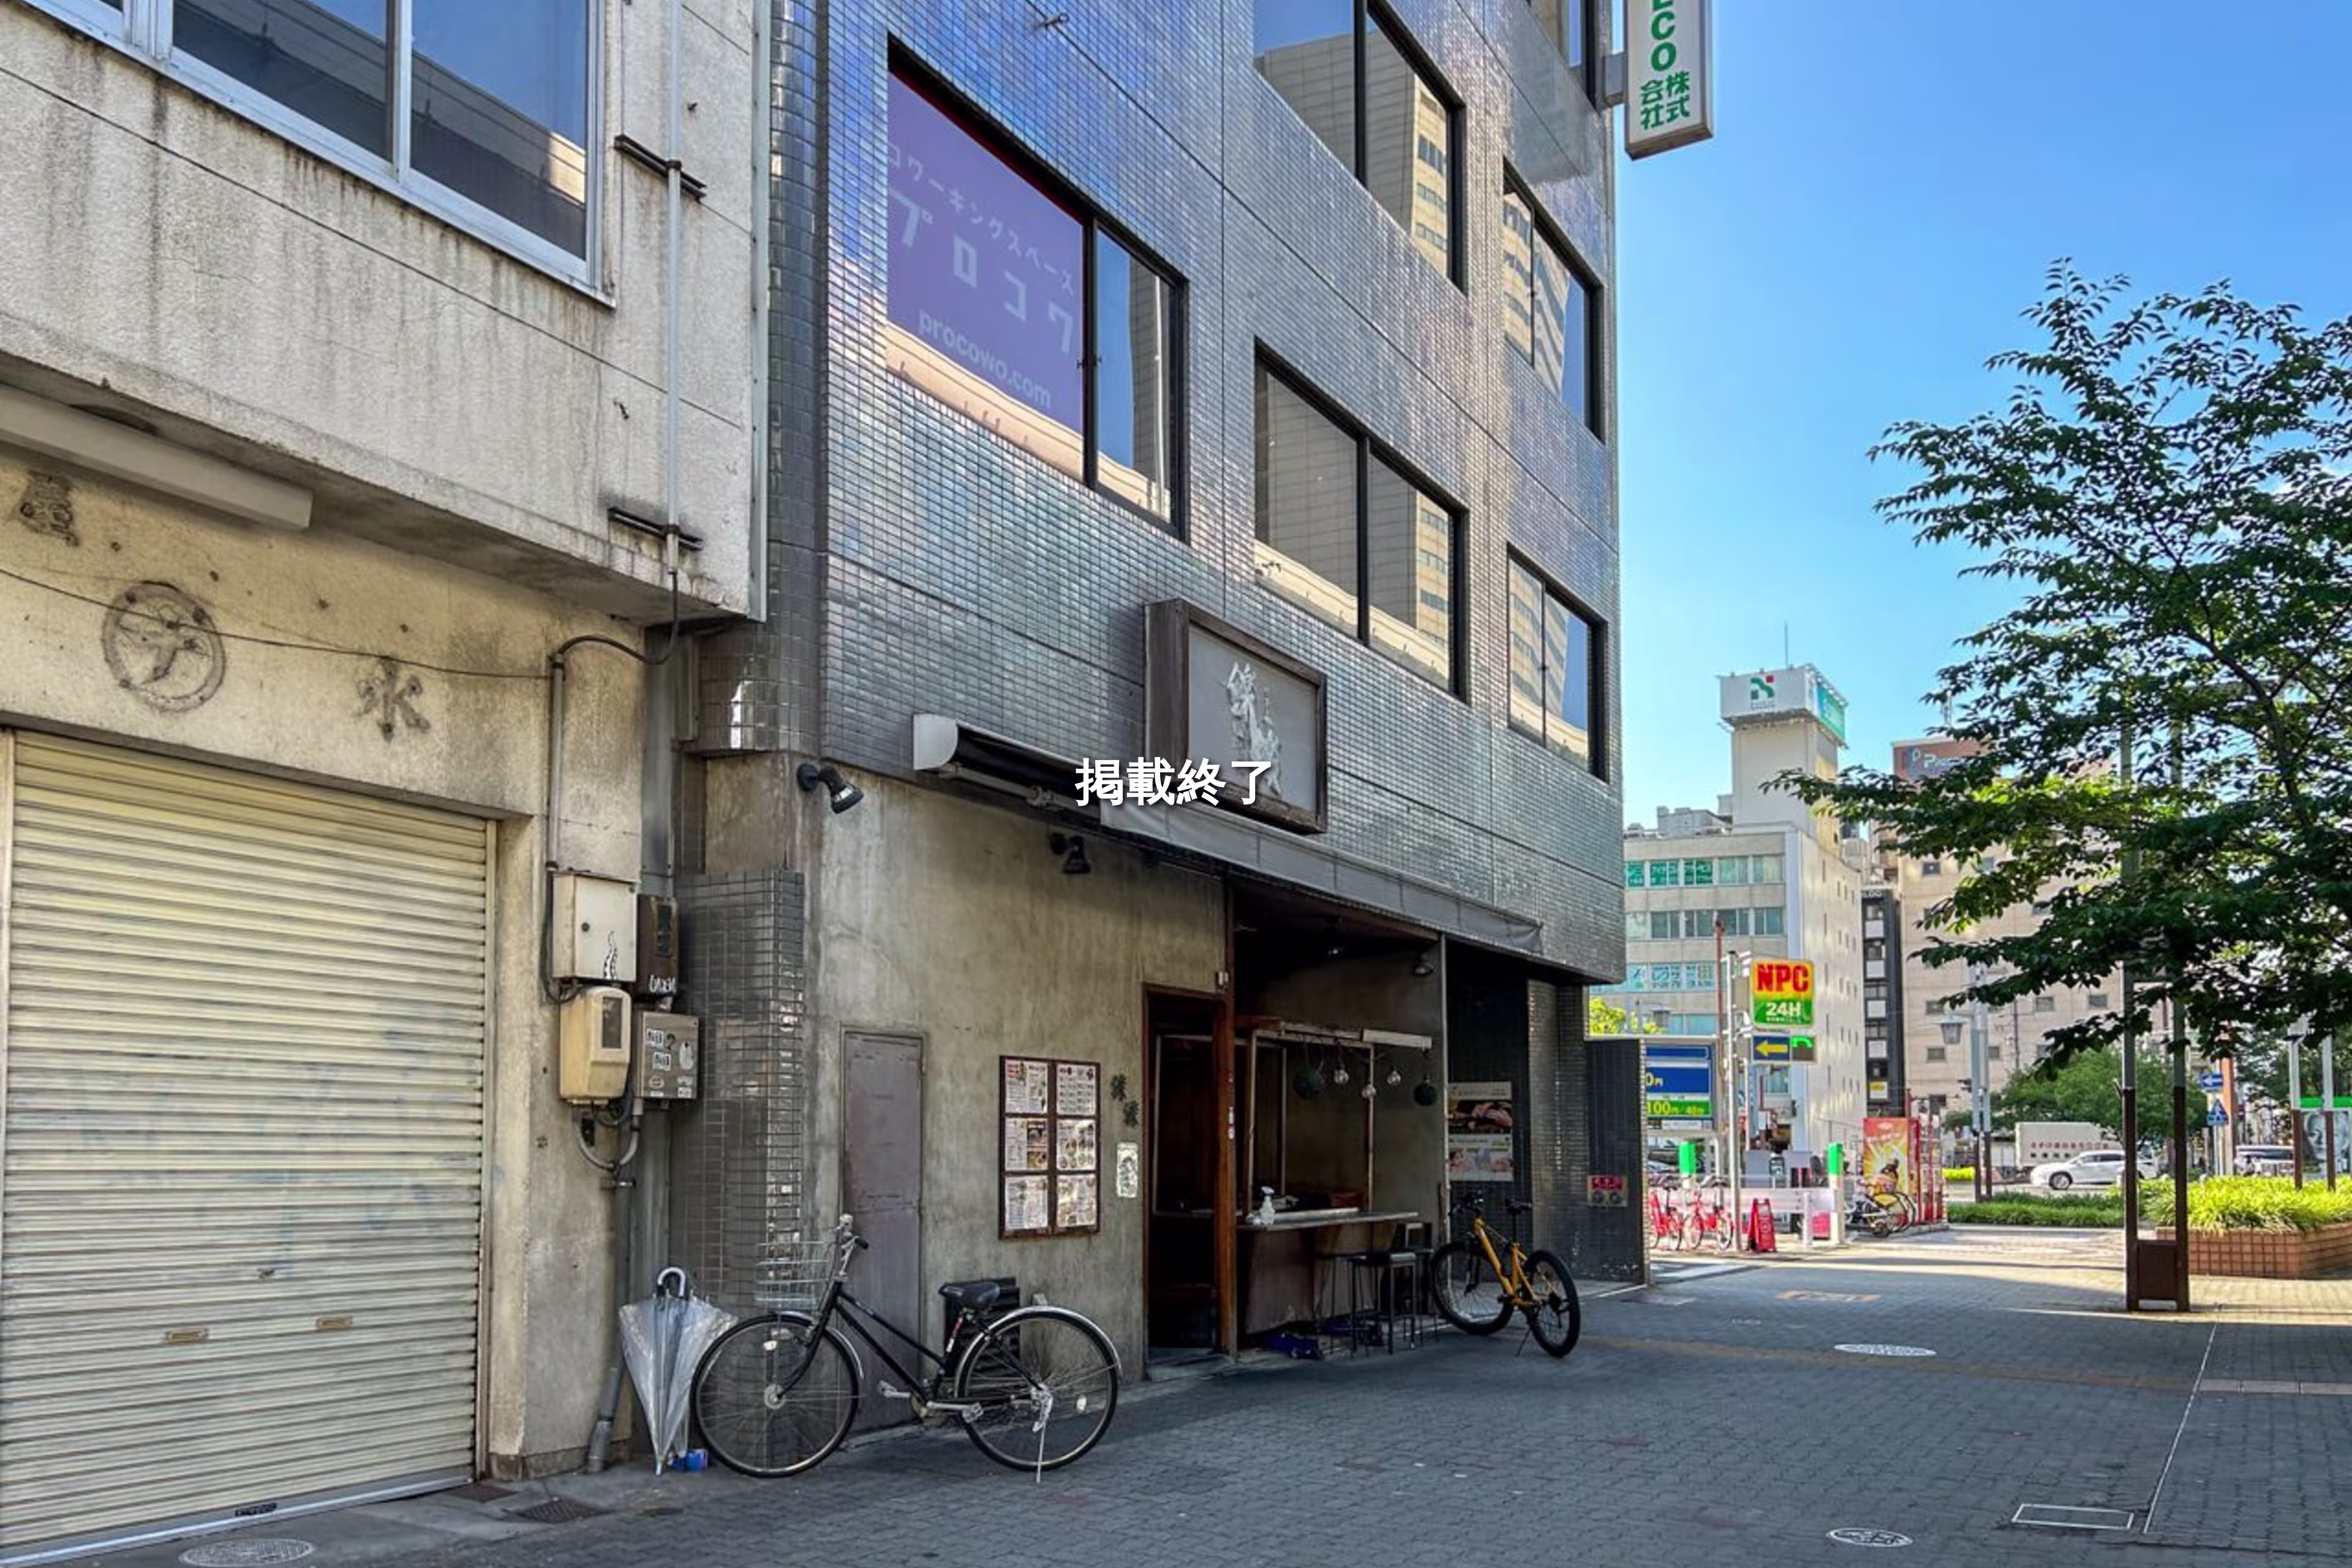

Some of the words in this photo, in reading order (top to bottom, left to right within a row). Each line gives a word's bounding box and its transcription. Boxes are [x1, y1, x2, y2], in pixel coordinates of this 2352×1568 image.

[888, 142, 1074, 297] コワーキングスペース
[889, 186, 1075, 355] プロコワ
[918, 309, 1051, 410] procowo.com
[1757, 963, 1809, 993] NPC
[1766, 1001, 1802, 1017] 24H
